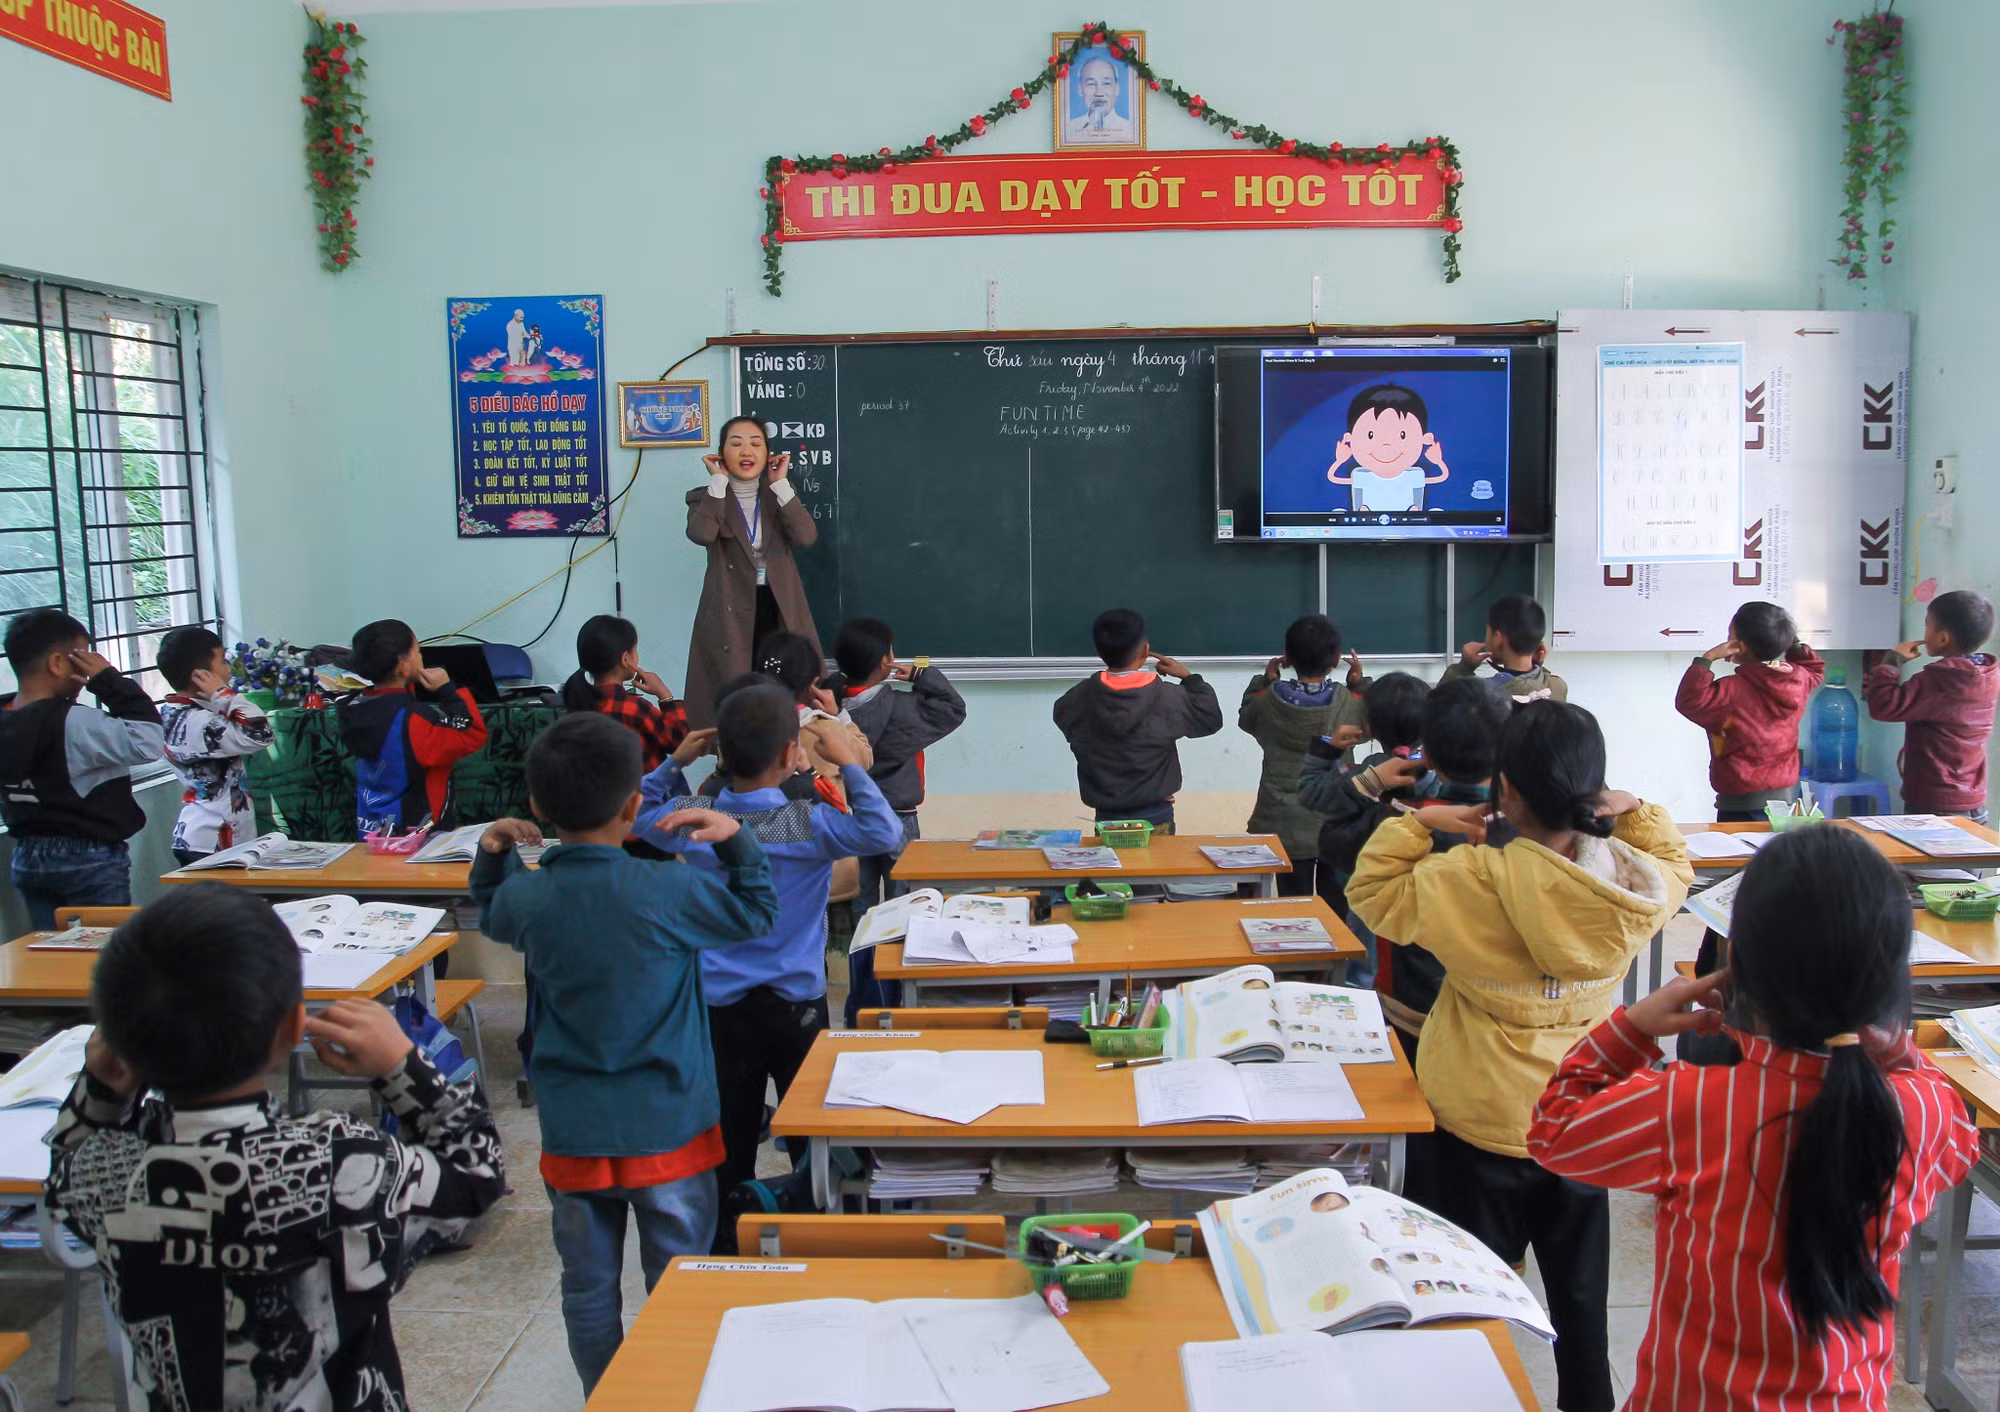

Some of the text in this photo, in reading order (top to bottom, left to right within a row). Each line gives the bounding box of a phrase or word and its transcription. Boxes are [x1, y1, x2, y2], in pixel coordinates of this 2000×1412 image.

[43, 0, 120, 60] THUỘC
[125, 28, 162, 77] BÀI
[805, 184, 875, 217] THI
[890, 181, 985, 215] ĐUA
[1000, 178, 1090, 217] DẠY
[1104, 165, 1186, 209] TỐT
[1234, 174, 1326, 214] HỌC
[1341, 162, 1424, 206] TỐT
[744, 352, 784, 372] TỔNG
[983, 346, 1022, 367] Thứ
[1060, 353, 1105, 378] ngày
[1108, 350, 1116, 366] 4
[1132, 344, 1187, 376] tháng
[470, 397, 478, 413] 5
[512, 392, 538, 412] BÁC
[562, 394, 586, 414] DẠY
[1000, 404, 1084, 420] FUN TIME
[1863, 381, 1894, 450] CKK
[472, 422, 479, 434] 1.
[482, 420, 495, 433] YÊU
[534, 419, 547, 432] YÊU
[572, 418, 586, 432] BÀO
[473, 434, 586, 453] 2. HỌC TẬP TỐT, LAO ĐỘNG TỐT
[474, 458, 480, 469] 3.
[484, 456, 503, 469] ĐOÀN
[507, 454, 520, 468] KẾT
[523, 454, 538, 469] TỐT,
[554, 455, 571, 470] LUẬT
[575, 452, 587, 468] TỐT
[519, 473, 528, 489] VỆ
[533, 475, 550, 486] SINH
[554, 472, 571, 488] THẬT
[576, 470, 588, 486] TỐT
[521, 491, 537, 507] THẬT
[1860, 518, 1890, 586] CKK
